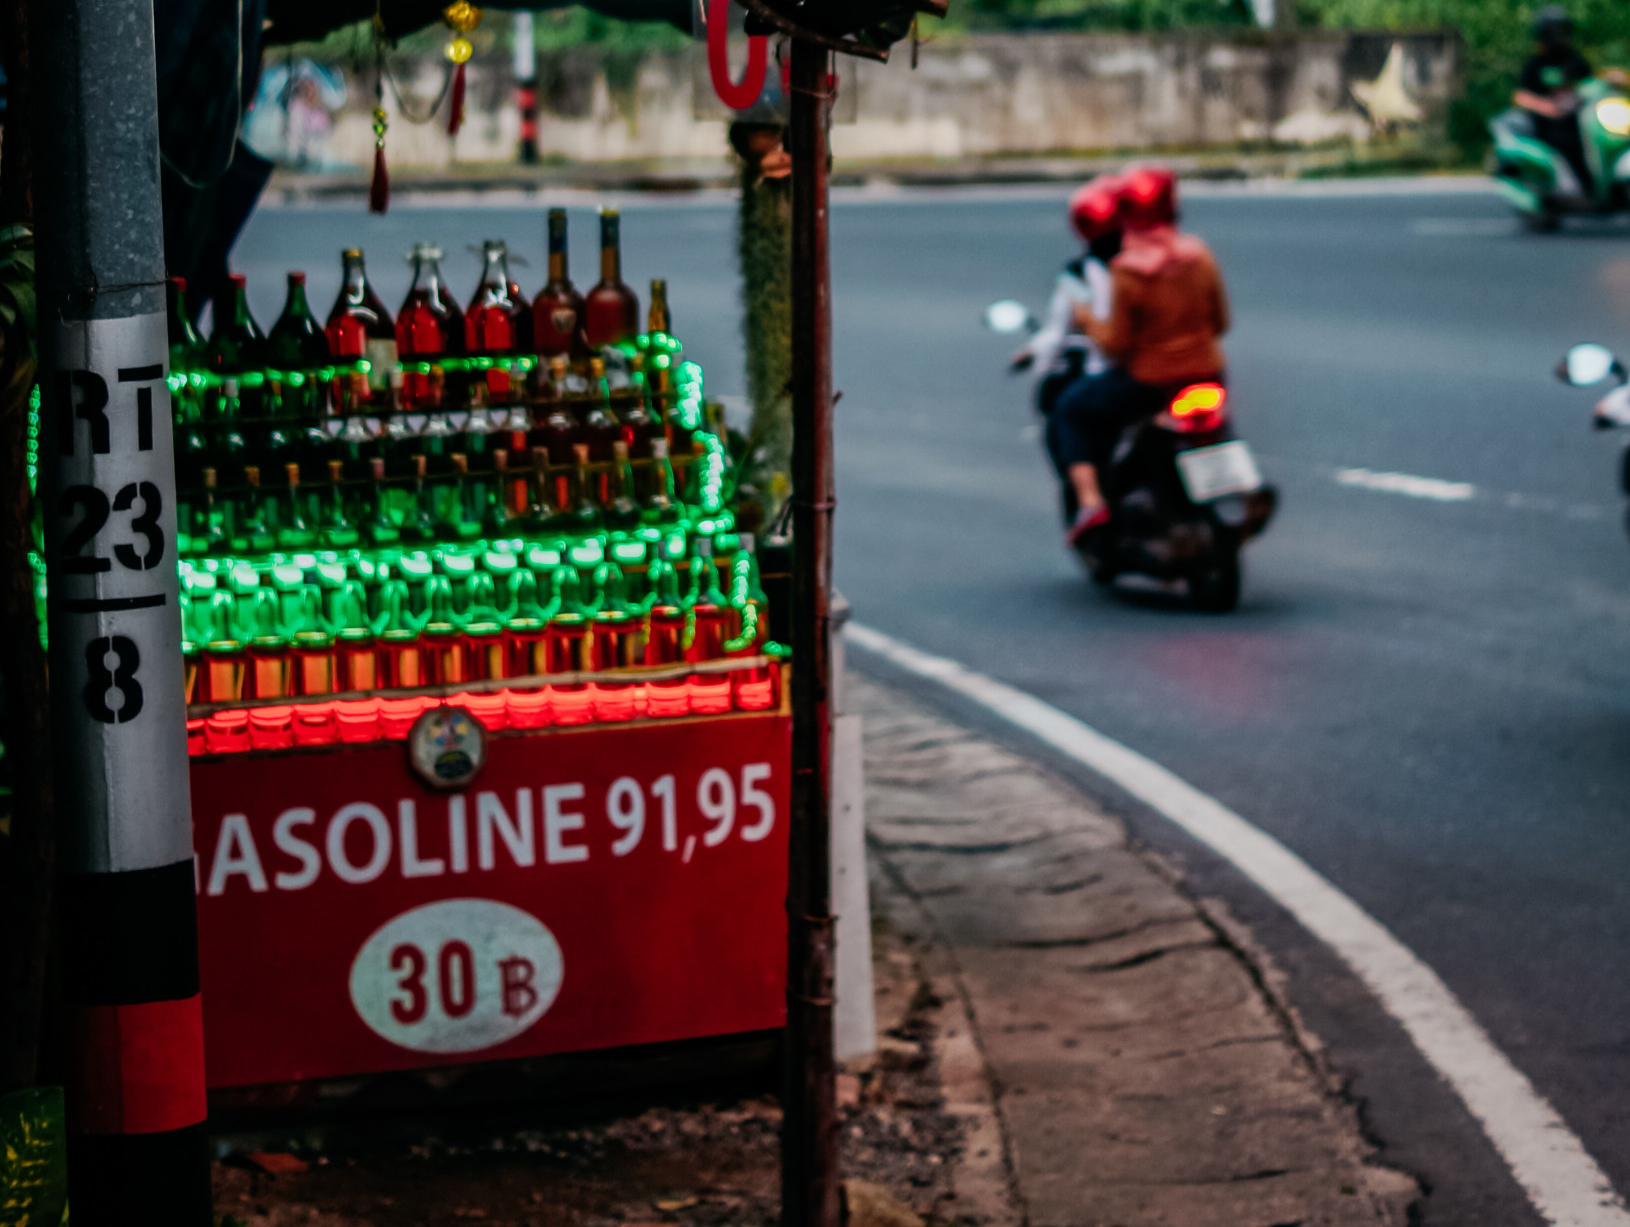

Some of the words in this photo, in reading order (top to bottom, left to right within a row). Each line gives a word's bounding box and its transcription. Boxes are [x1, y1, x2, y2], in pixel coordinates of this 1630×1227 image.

[55, 364, 163, 456] RT
[59, 481, 164, 573] 23
[85, 635, 144, 724] 8
[194, 782, 590, 897] ASOLINE
[606, 762, 776, 864] 91,95
[388, 940, 477, 1027] 30
